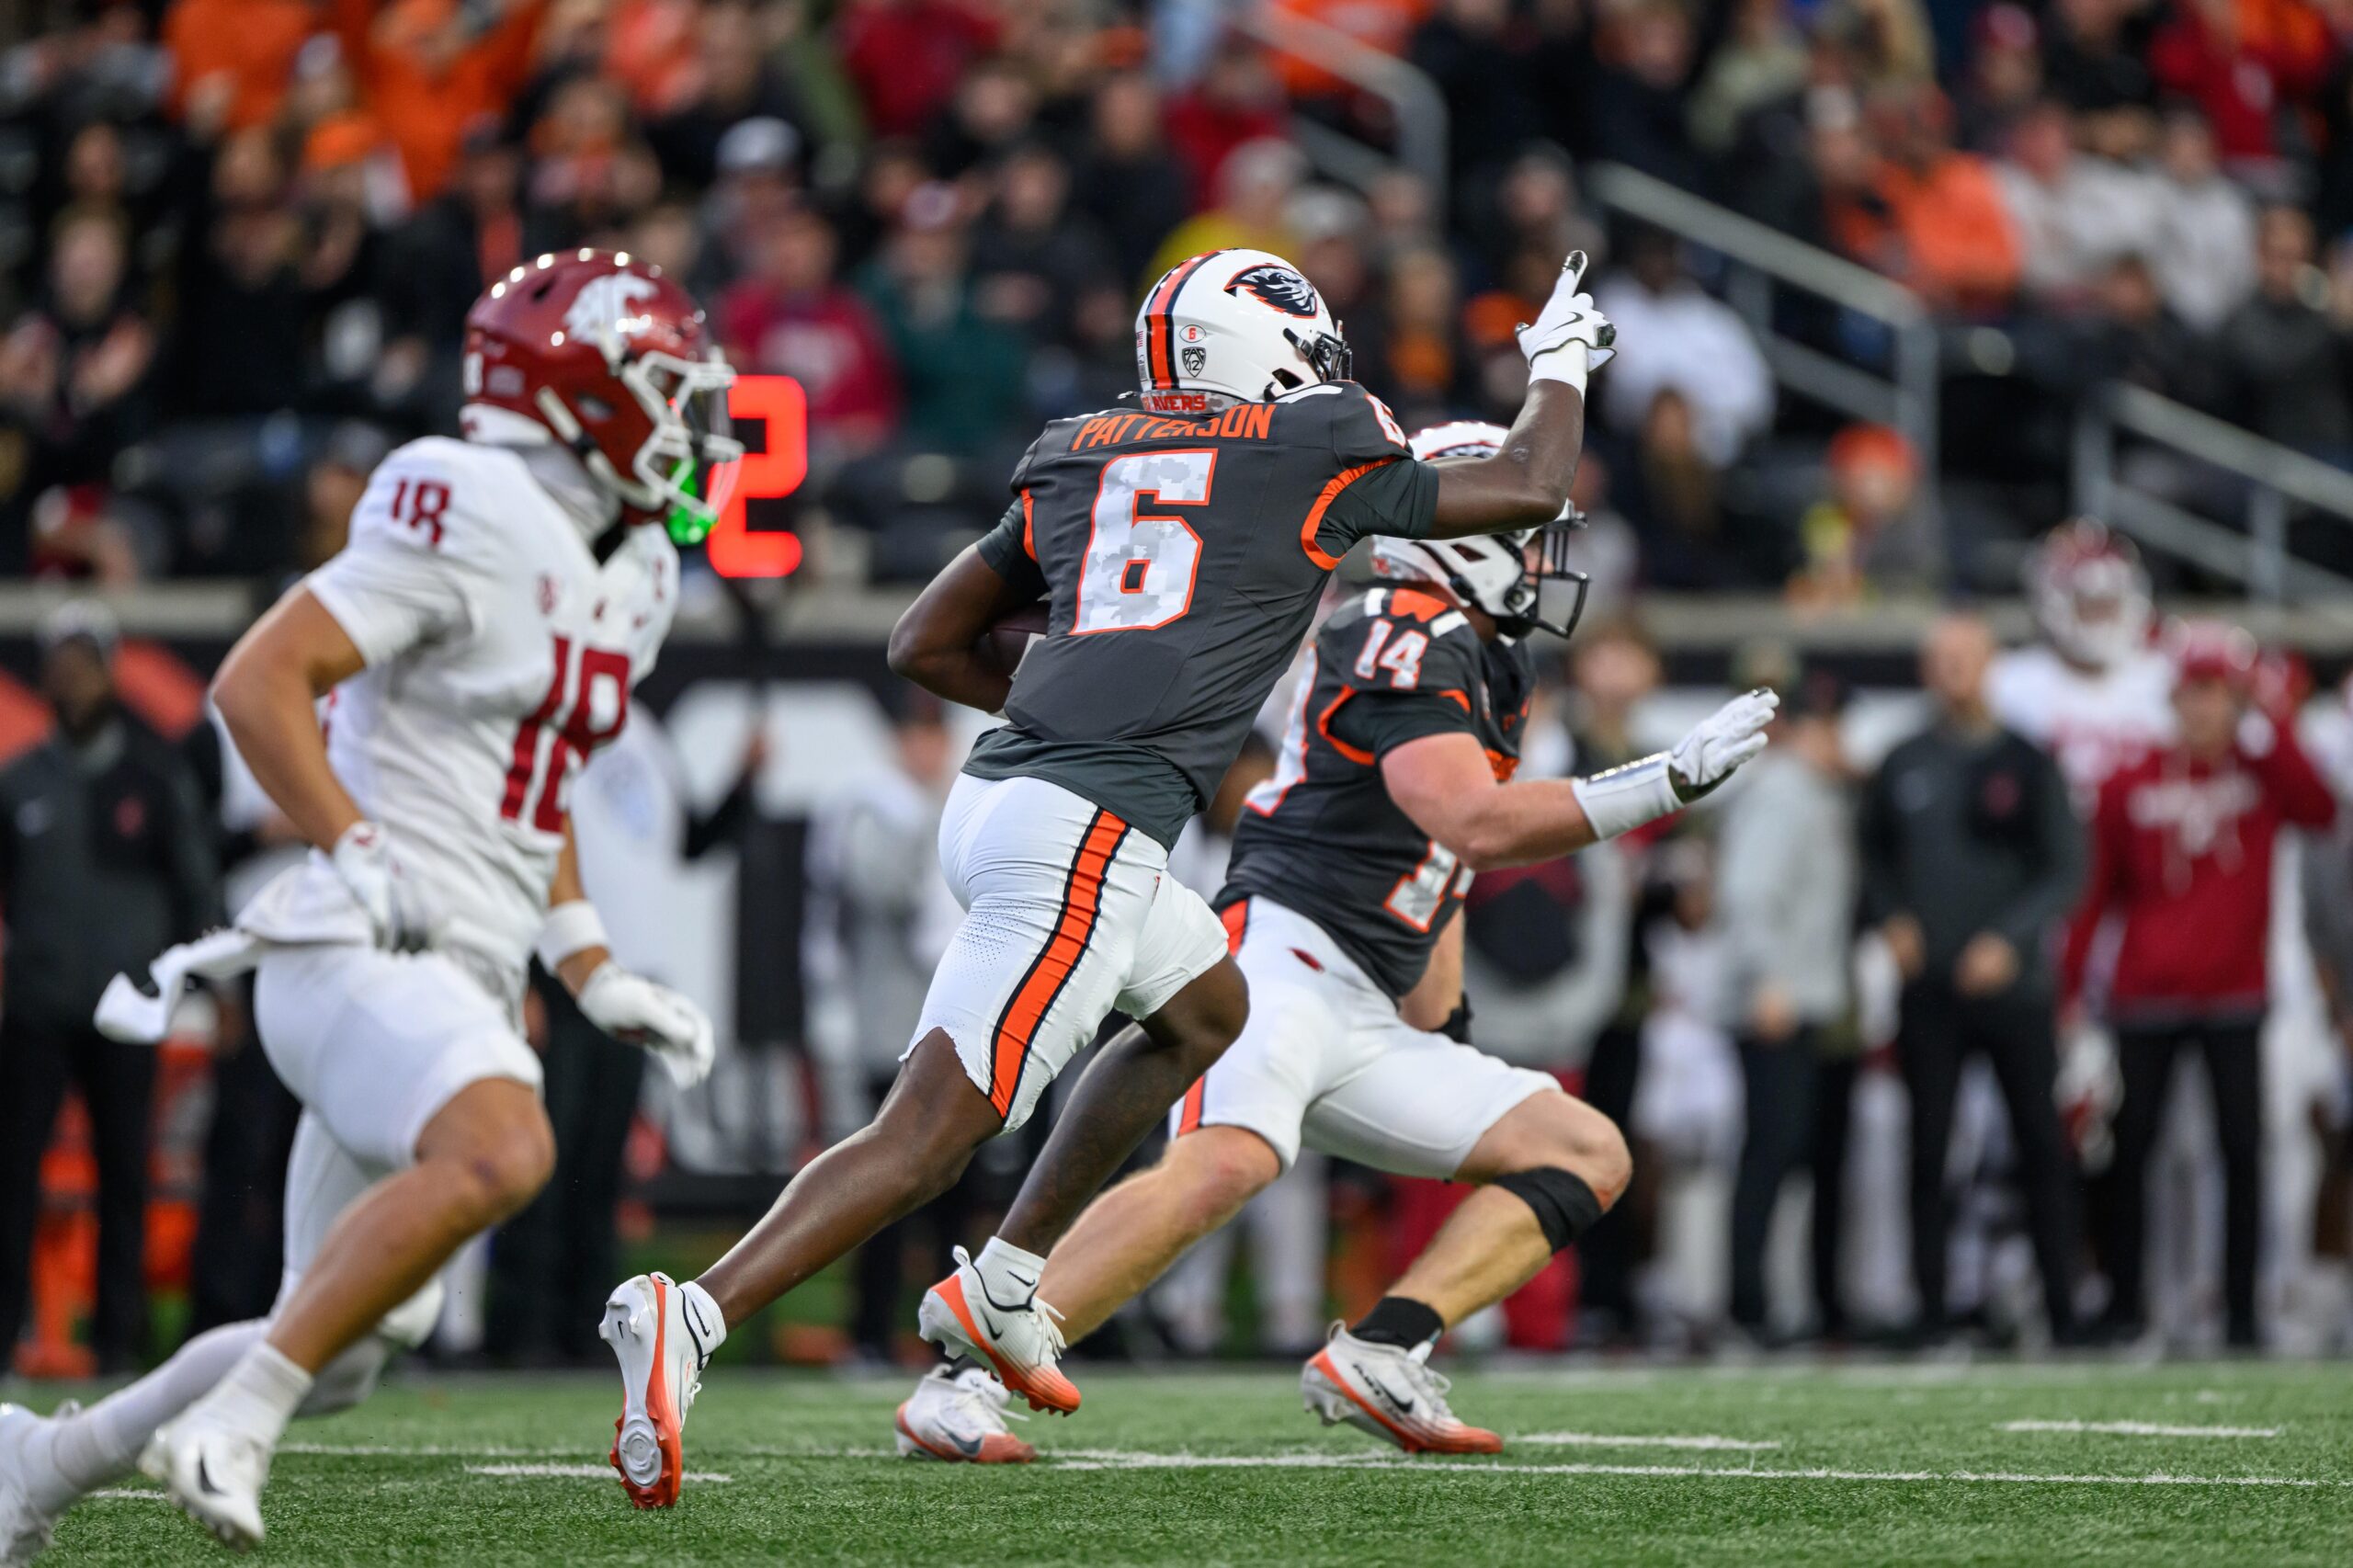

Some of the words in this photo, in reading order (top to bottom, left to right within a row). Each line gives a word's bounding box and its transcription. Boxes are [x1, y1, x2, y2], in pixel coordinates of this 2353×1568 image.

[1188, 327, 1197, 340] 6
[1188, 359, 1200, 371] 12
[1071, 404, 1277, 451] PATTERSON
[706, 375, 808, 578] 2
[1068, 448, 1219, 636] 6
[1354, 618, 1428, 690] 14
